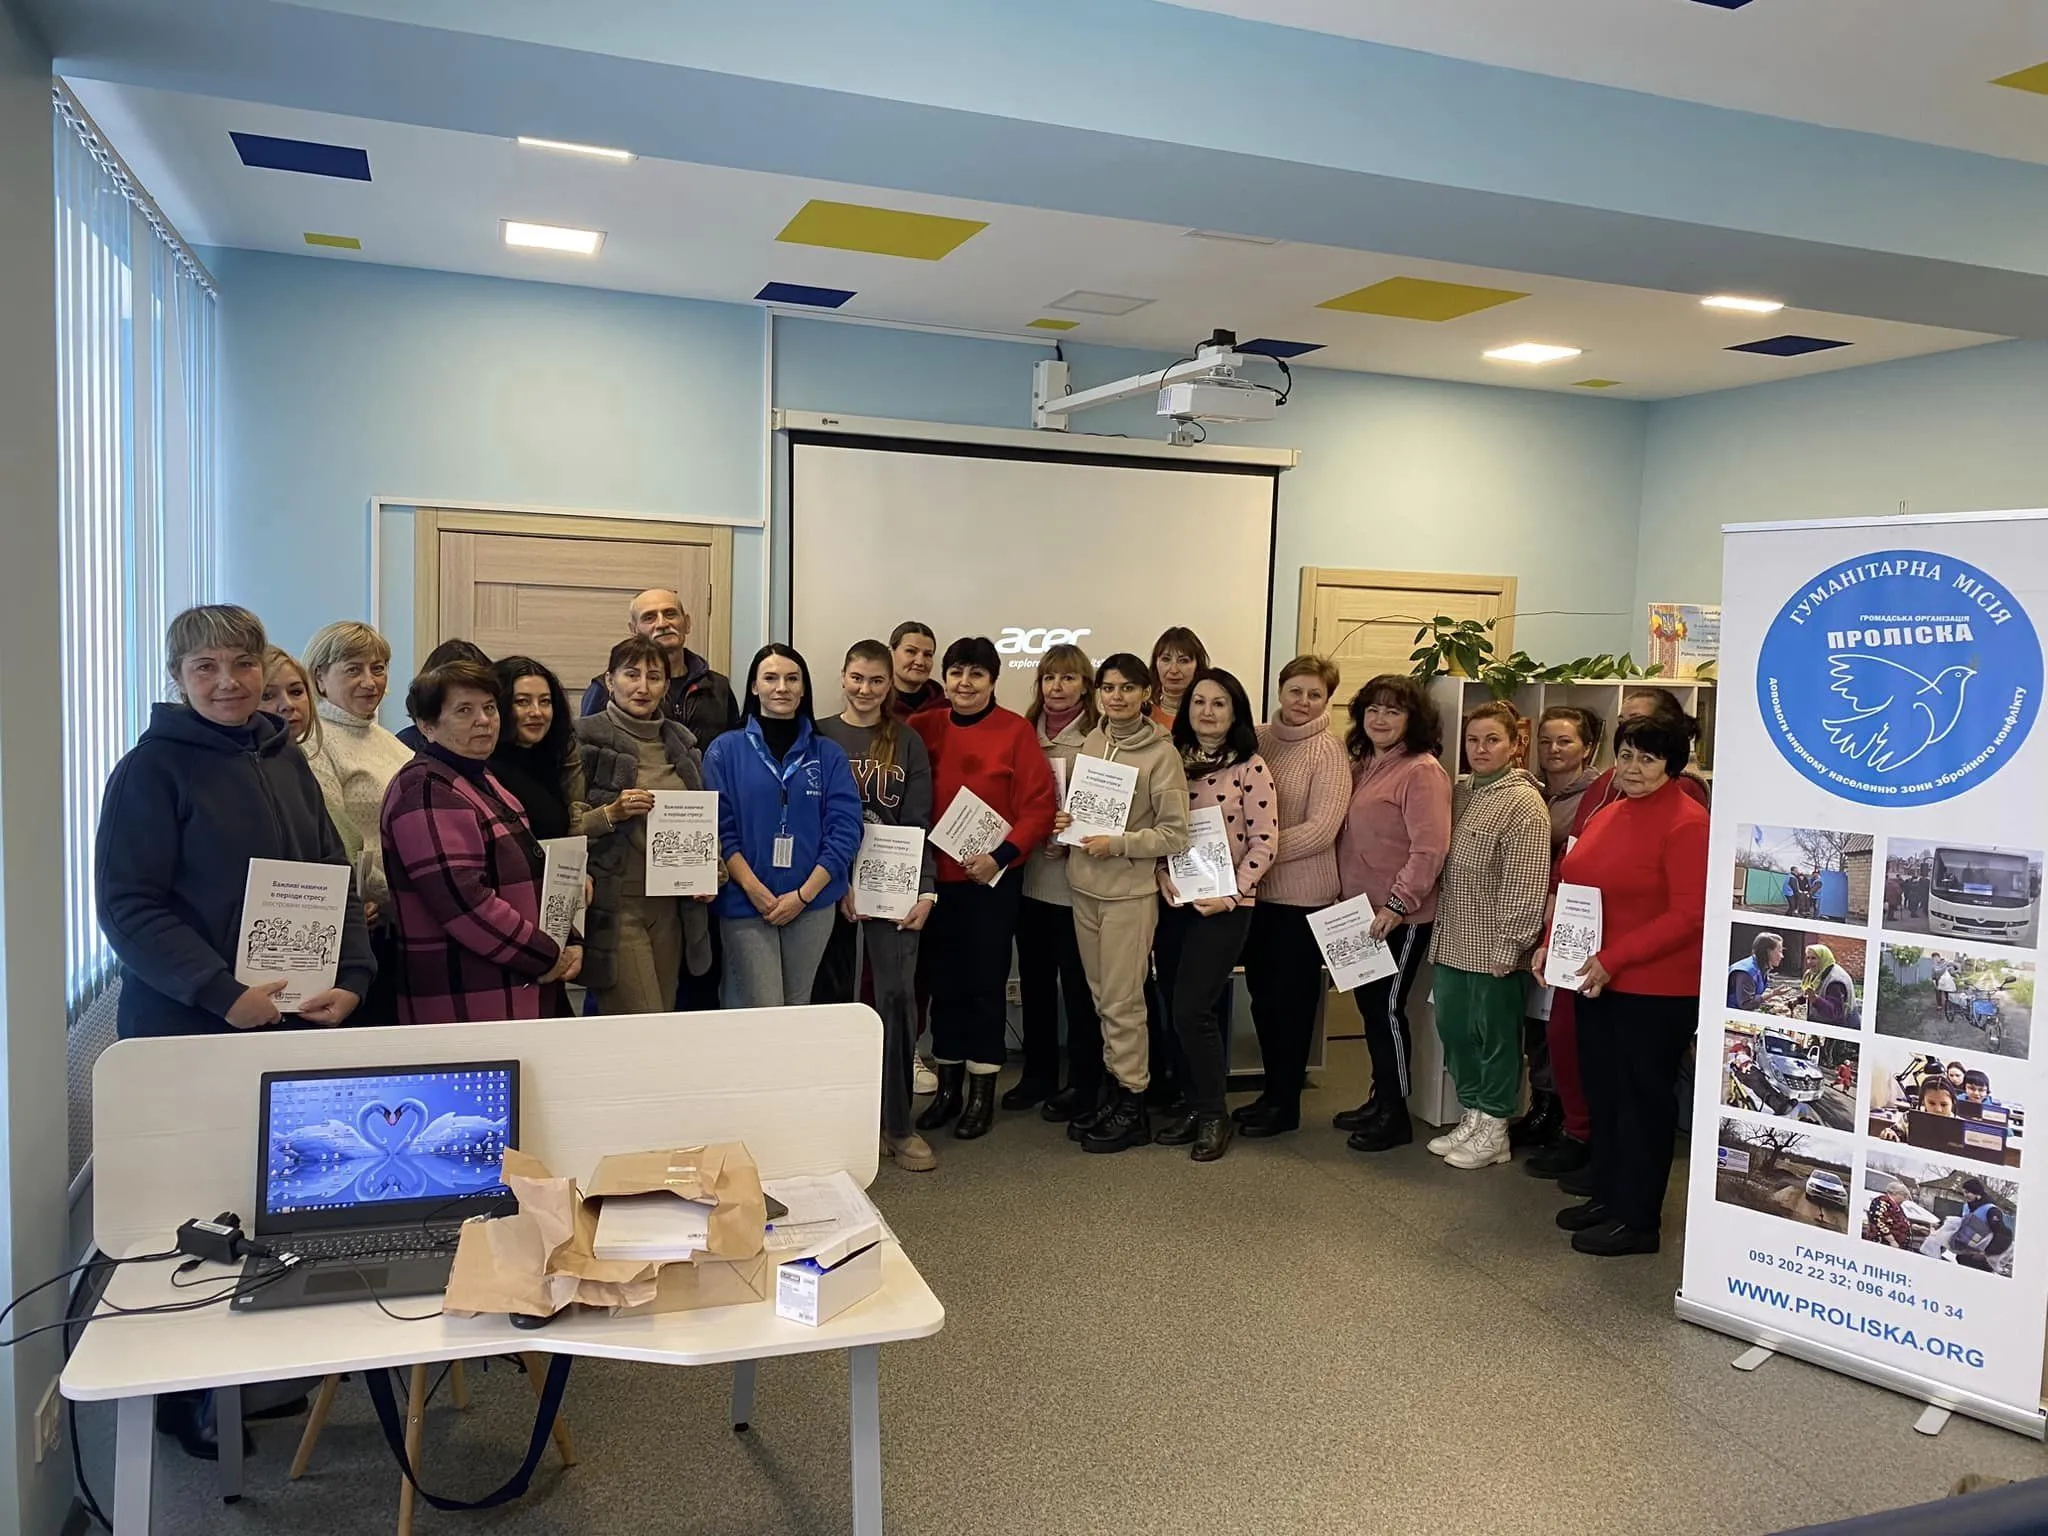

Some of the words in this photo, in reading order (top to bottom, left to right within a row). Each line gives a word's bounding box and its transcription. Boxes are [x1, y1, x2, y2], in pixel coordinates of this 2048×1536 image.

[1790, 560, 1942, 624] ГУМАНІТАРНА
[1952, 573, 2012, 626] МІСІЯ
[994, 627, 1092, 654] acer
[1827, 623, 1974, 649] ПРОЛІСКА
[1785, 732, 1829, 774] мирному
[1828, 770, 1897, 794] населенню
[1900, 782, 1933, 794] зони
[1936, 745, 1996, 787] збройного
[1993, 686, 2027, 746] конфлікту
[1749, 1250, 1774, 1266] 093
[1779, 1258, 1803, 1274] 202
[1808, 1266, 1824, 1280] 22
[1829, 1271, 1852, 1289] 32;
[1857, 1280, 1883, 1297] 096
[1888, 1289, 1915, 1306] 404
[1922, 1299, 1939, 1313] 10
[1945, 1305, 1964, 1320] 34
[1796, 1246, 1857, 1273] ГАРЯЧА
[1862, 1264, 1912, 1288] ЛІНІЯ:
[1727, 1277, 1985, 1368] WWW.PROLISKA.ORG
